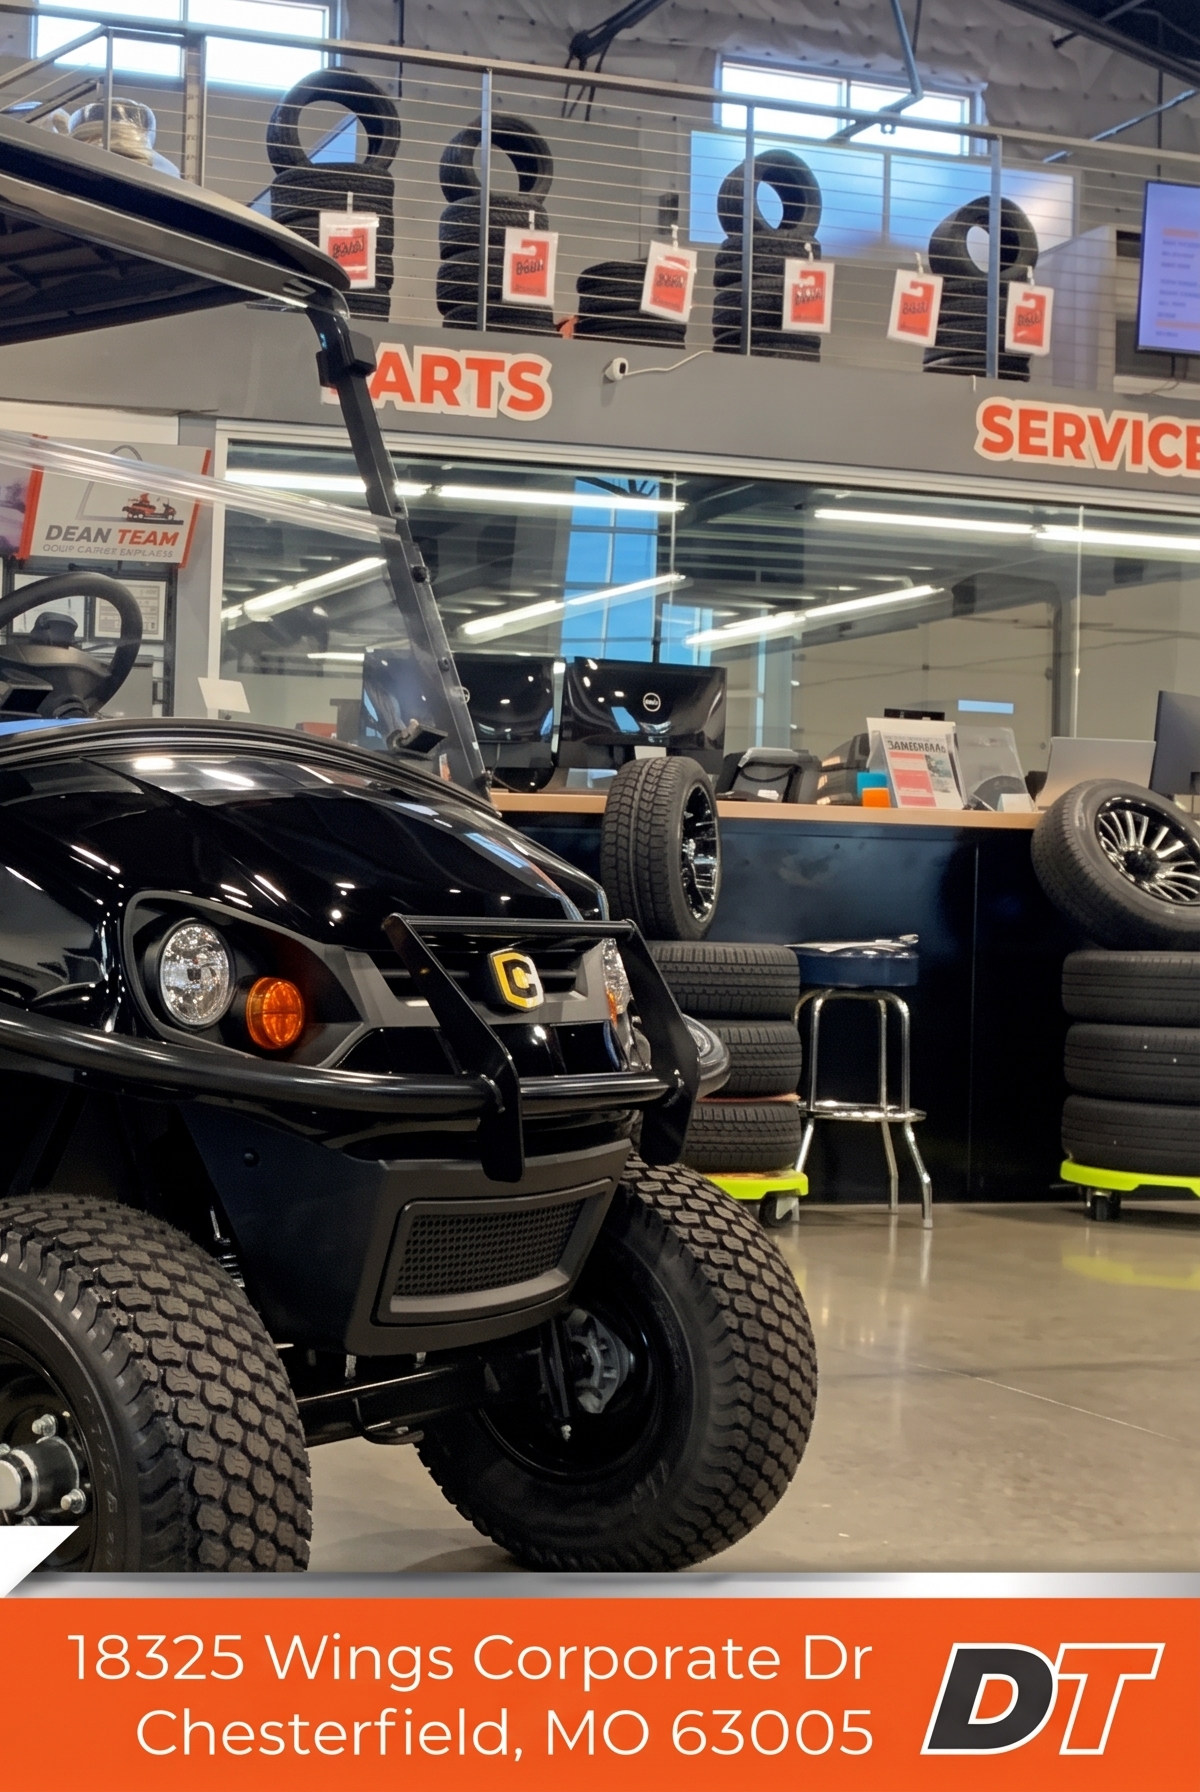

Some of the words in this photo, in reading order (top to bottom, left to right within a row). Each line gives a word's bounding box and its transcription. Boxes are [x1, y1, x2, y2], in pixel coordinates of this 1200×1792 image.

[331, 350, 546, 413] ARTS
[45, 524, 112, 544] DEAN
[118, 529, 179, 547] TEAM
